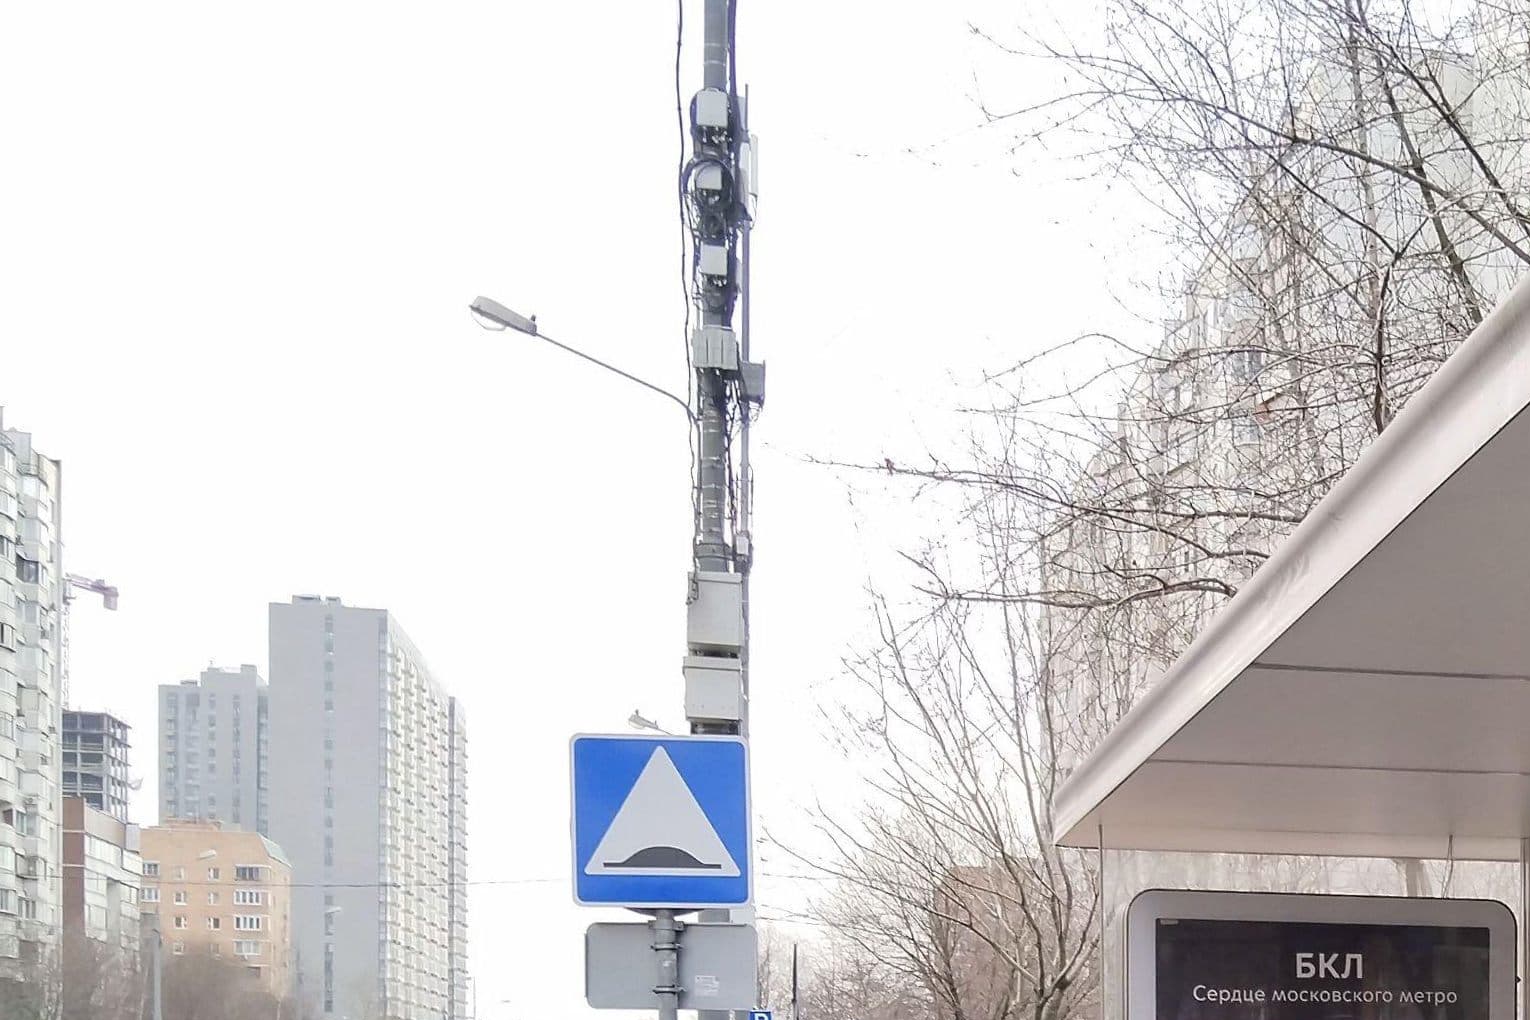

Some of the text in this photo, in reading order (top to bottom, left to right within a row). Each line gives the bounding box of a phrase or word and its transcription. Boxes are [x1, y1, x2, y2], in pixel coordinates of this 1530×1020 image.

[1295, 952, 1364, 980] БКЛ
[1192, 984, 1459, 1006] Сердце московского метро
